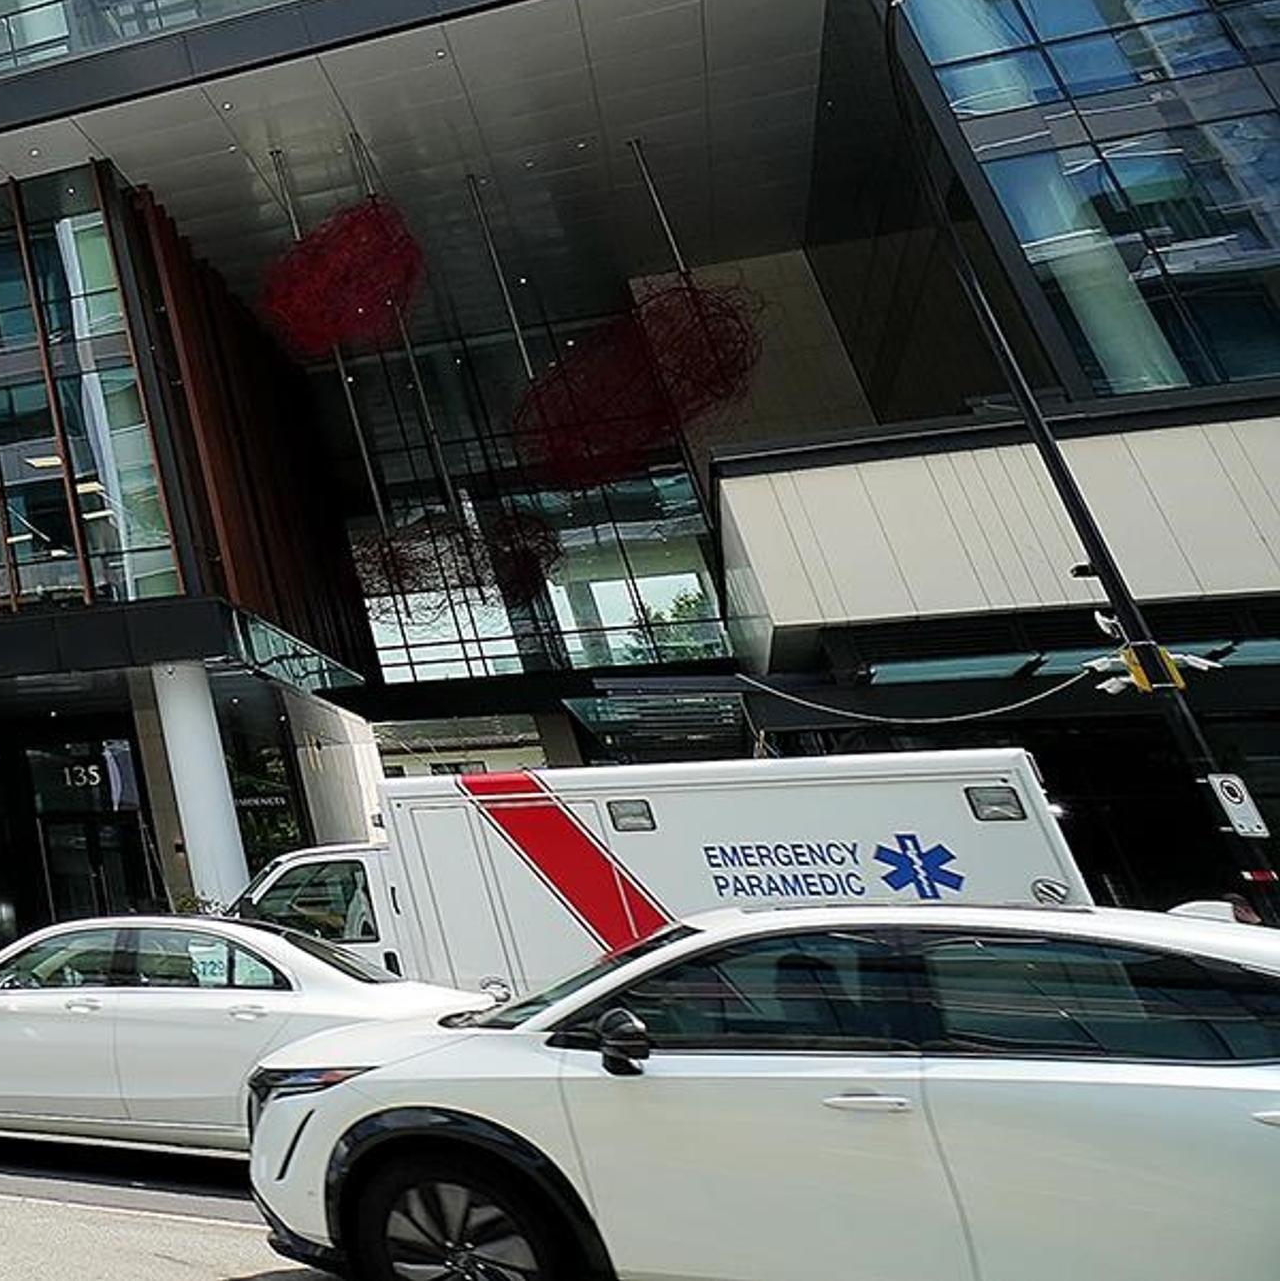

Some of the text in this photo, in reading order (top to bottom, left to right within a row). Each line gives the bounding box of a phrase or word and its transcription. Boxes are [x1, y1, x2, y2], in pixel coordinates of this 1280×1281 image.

[63, 764, 102, 787] 135
[703, 842, 861, 869] EMERGENCY
[713, 873, 867, 898] PARAMEDIC
